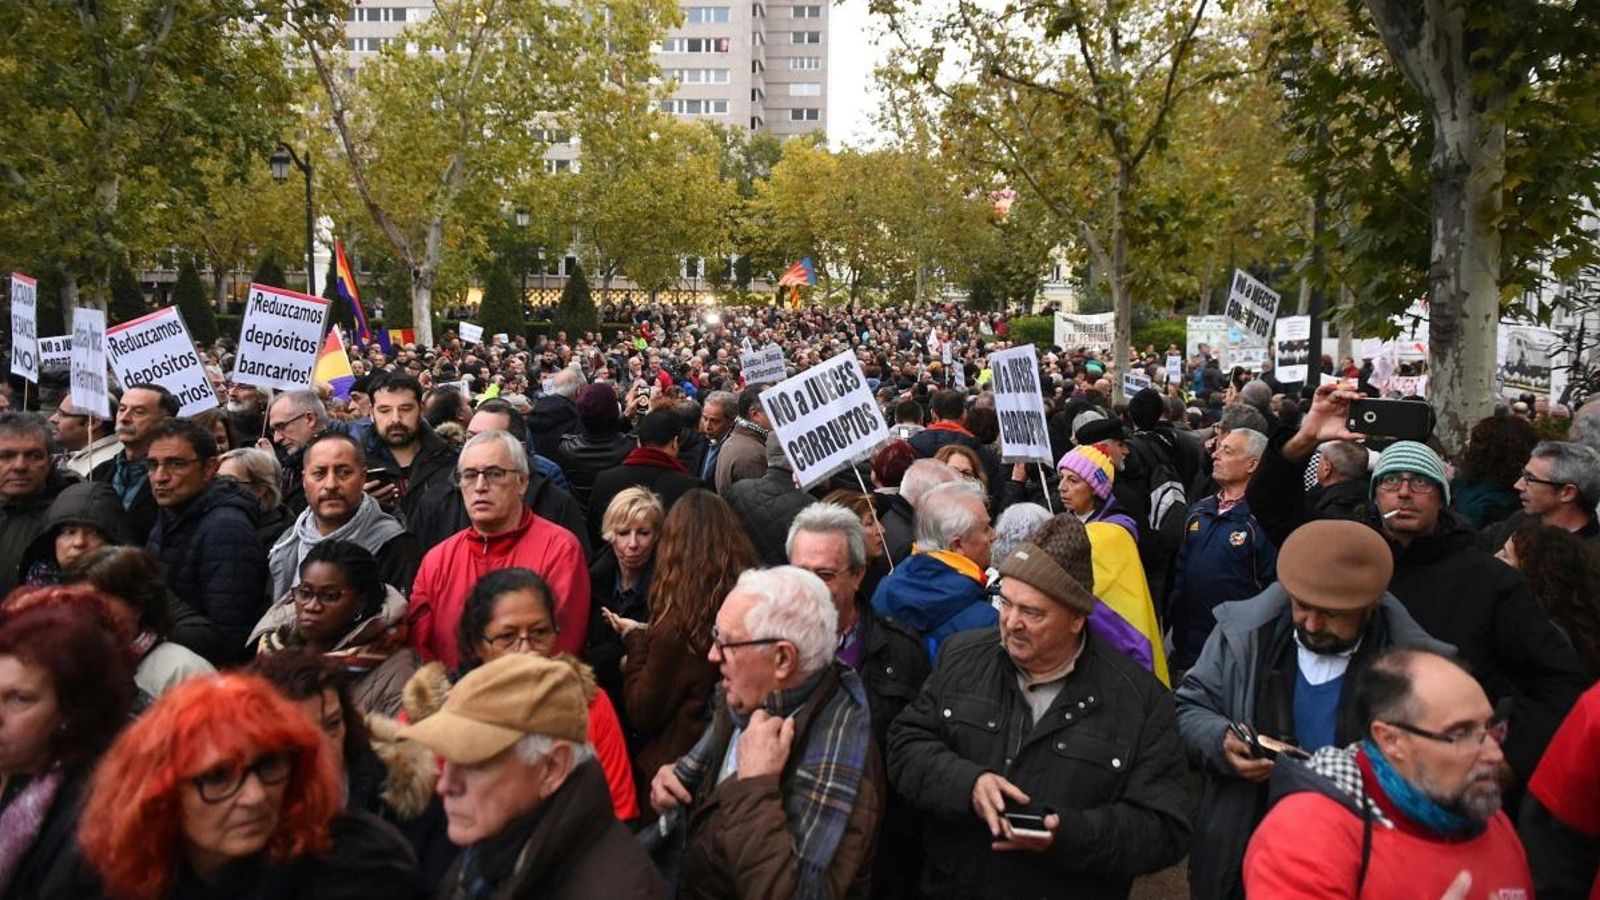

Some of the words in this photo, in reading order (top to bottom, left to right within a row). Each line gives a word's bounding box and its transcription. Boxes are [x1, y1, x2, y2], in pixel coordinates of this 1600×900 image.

[1235, 273, 1247, 294] NO
[1245, 284, 1252, 298] a
[250, 292, 323, 324] ¡Reduzcamos
[41, 341, 53, 354] NO
[55, 343, 61, 352] a
[108, 320, 182, 364] ¡Reduzcamos
[245, 323, 317, 354] depósitos
[13, 346, 37, 374] NO!
[123, 351, 198, 390] depósitos
[238, 353, 312, 385] bancarios!
[992, 360, 1005, 394] NO
[1002, 365, 1013, 394] a
[1008, 356, 1037, 394] JUECES
[767, 391, 797, 428] NO
[794, 390, 810, 416] a
[804, 361, 861, 410] JUECES
[787, 402, 879, 472] CORRUPTOS
